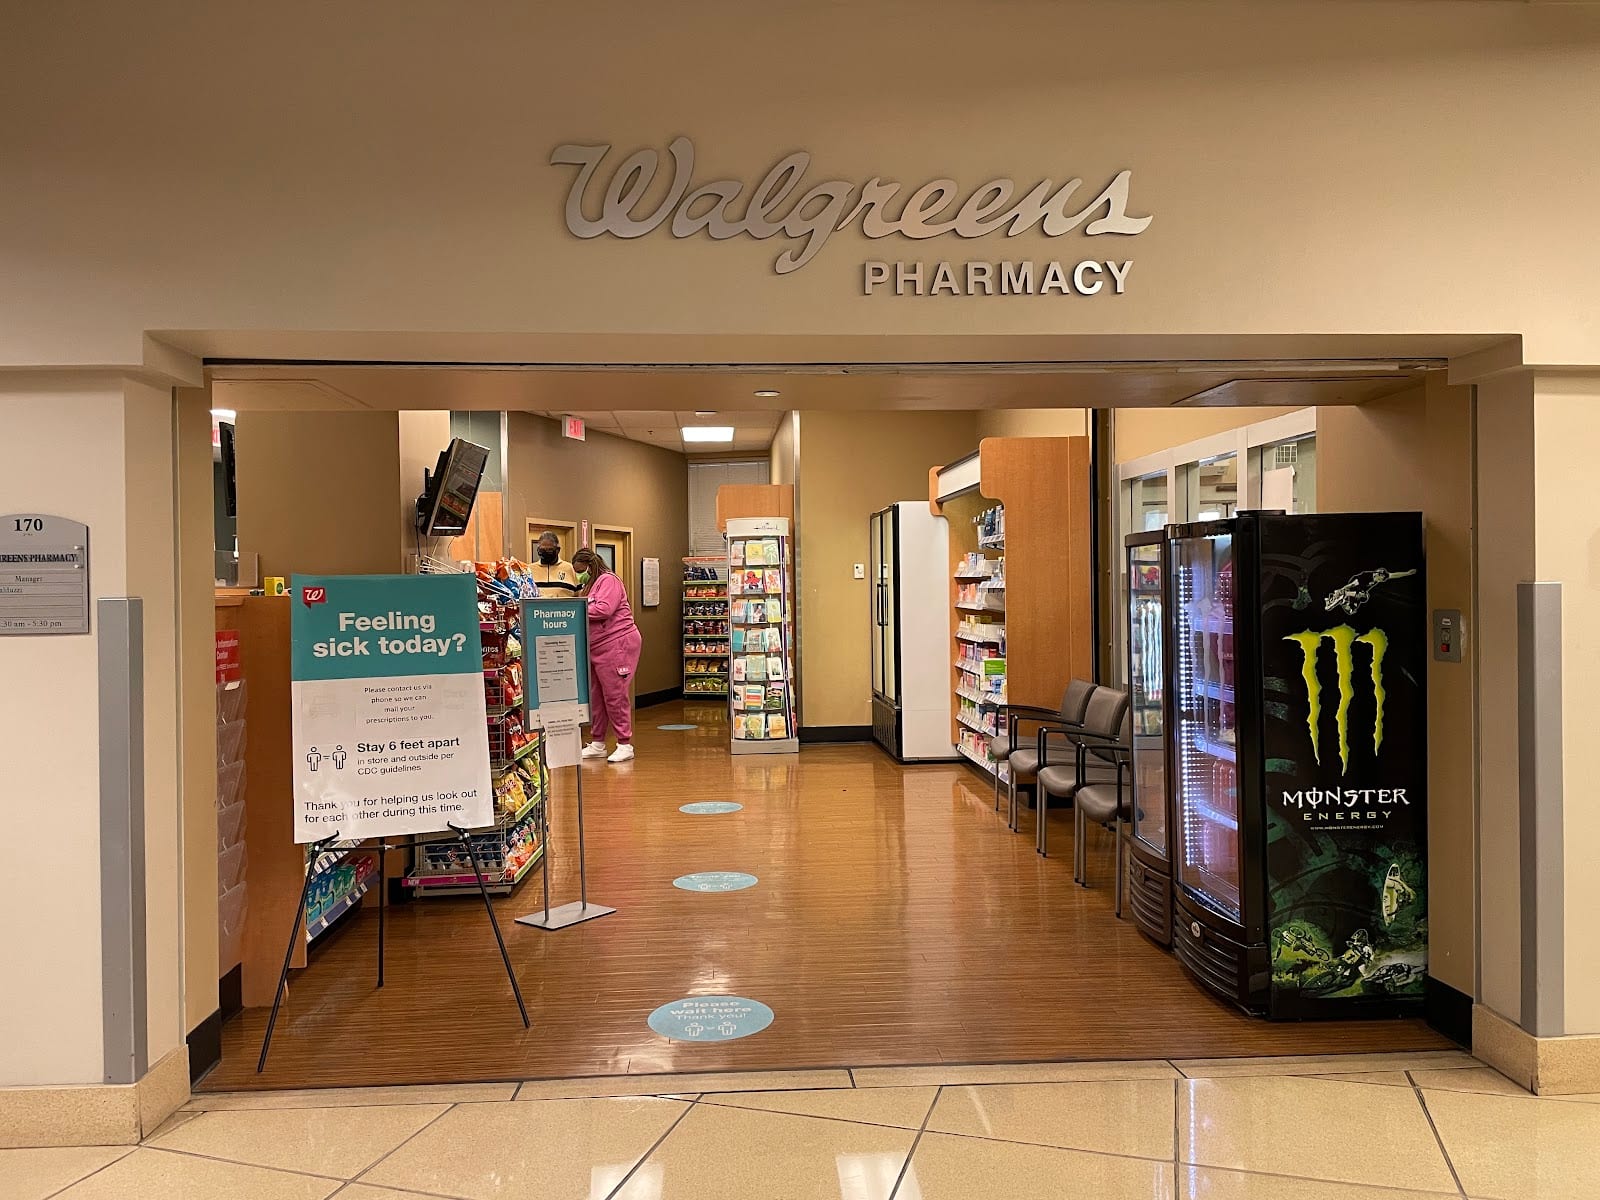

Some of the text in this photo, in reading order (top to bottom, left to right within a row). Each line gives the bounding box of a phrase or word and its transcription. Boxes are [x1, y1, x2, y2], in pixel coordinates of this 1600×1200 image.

[549, 137, 1153, 274] Walgreens
[863, 260, 1134, 296] PHARMACY
[14, 518, 43, 532] 170
[0, 553, 77, 563] REENS PHARMACY
[533, 609, 576, 619] Pharmacy
[50, 621, 62, 629] pm
[339, 611, 436, 633] Feeling
[543, 619, 567, 629] hours
[313, 633, 466, 658] sick today?
[366, 715, 410, 724] prescriptions
[357, 737, 460, 753] Stay 6 feet apart
[367, 757, 389, 765] store
[390, 754, 407, 763] and
[408, 753, 439, 762] outside
[357, 764, 422, 775] CDC guidelines
[304, 789, 477, 811] Thank you for helping us look out
[1282, 786, 1411, 809] MONSTER
[304, 802, 464, 823] for each other during this time.
[1303, 811, 1392, 821] ENERGY
[670, 1007, 706, 1015] wait
